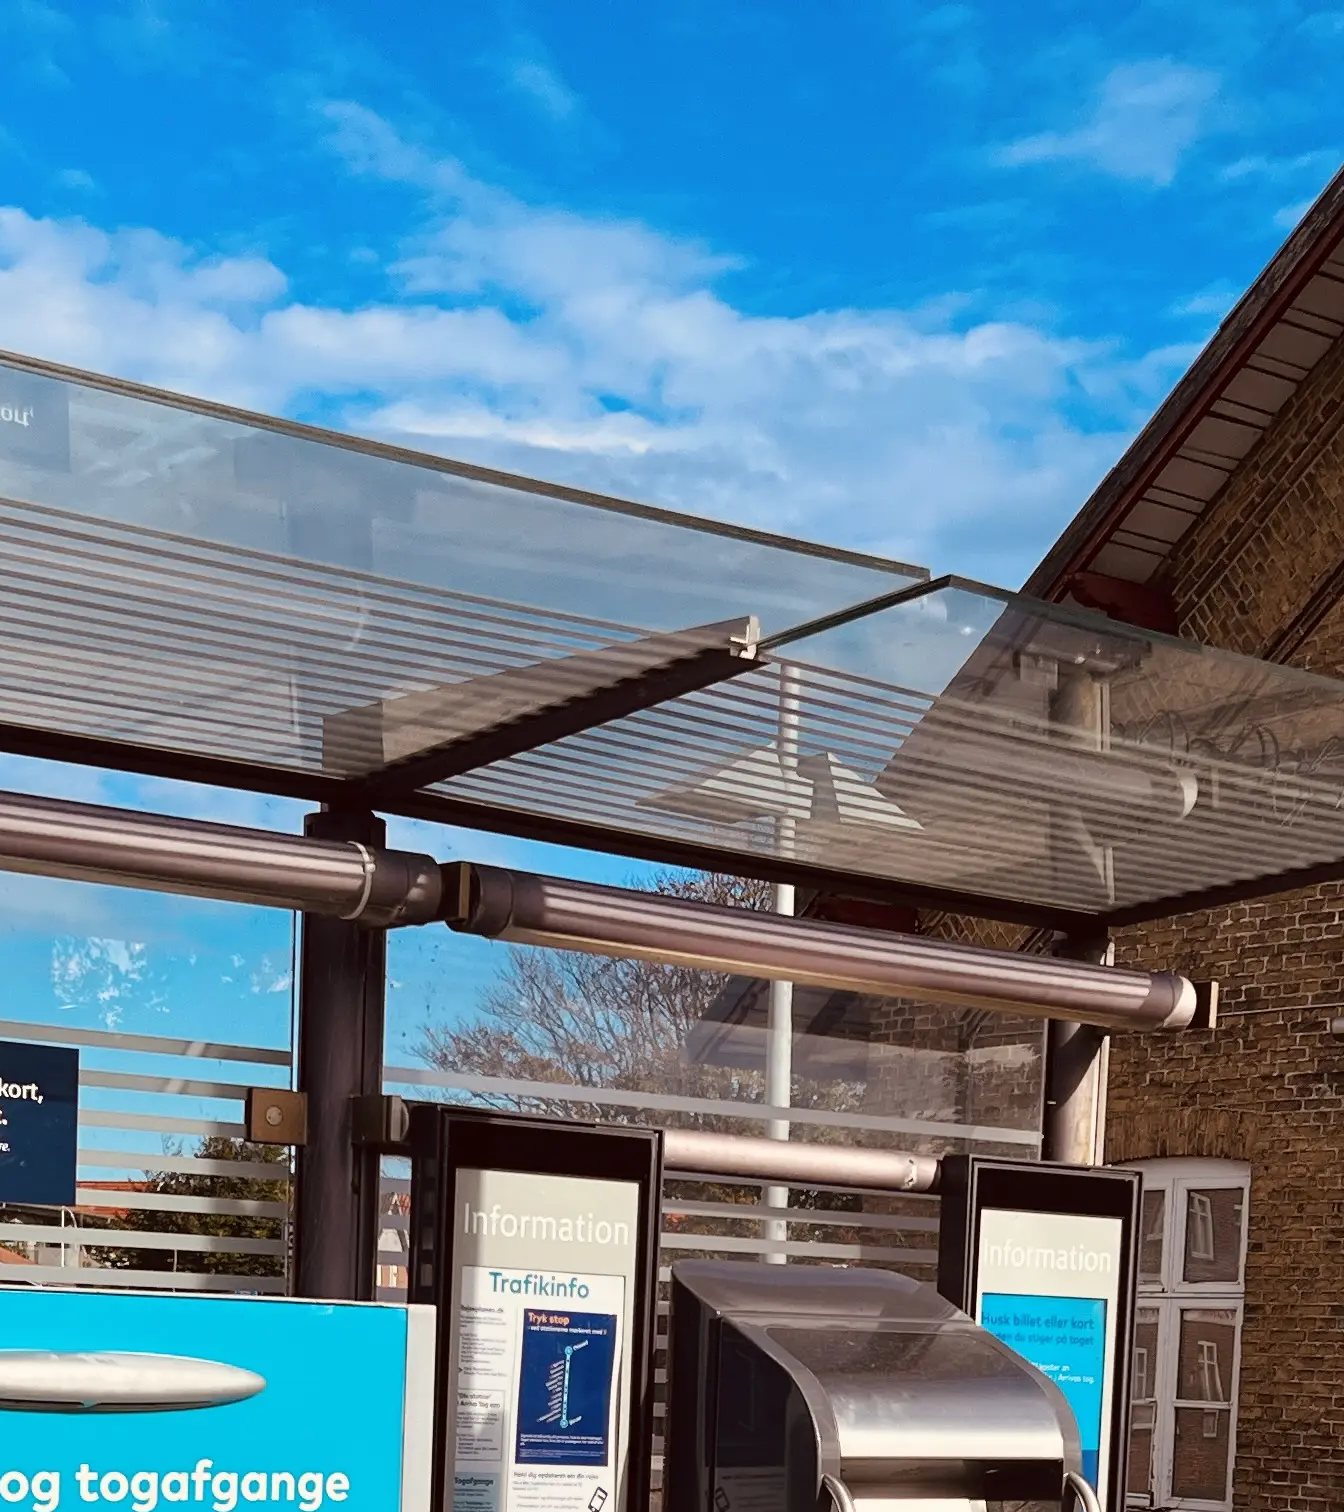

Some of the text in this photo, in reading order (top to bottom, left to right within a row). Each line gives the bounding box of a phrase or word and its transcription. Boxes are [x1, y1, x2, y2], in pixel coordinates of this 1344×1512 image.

[464, 1202, 629, 1245] Information
[983, 1239, 1111, 1273] Information
[488, 1272, 590, 1299] Trafikinfo
[528, 1312, 570, 1326] Tryk stop
[982, 1312, 1095, 1330] Husk billet eller kort
[76, 1459, 350, 1512] togafgange
